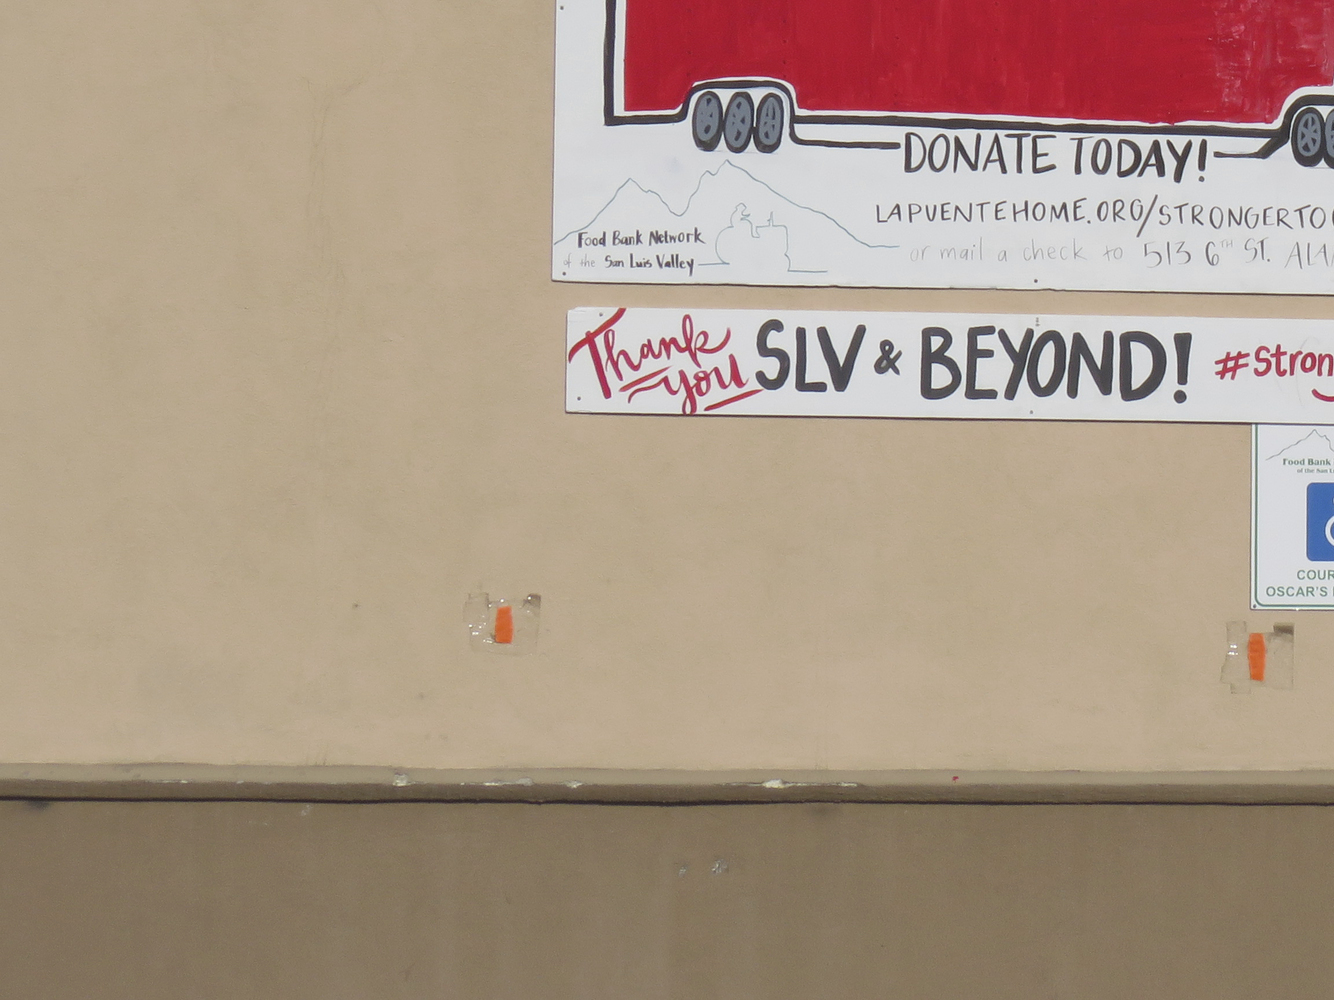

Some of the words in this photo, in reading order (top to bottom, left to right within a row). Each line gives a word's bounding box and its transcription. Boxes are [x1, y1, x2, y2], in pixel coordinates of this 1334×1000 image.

[902, 132, 1057, 175] DONATE
[1070, 136, 1208, 183] TODAY!
[578, 231, 606, 248] Food
[612, 230, 643, 246] Bank
[649, 227, 706, 246] Network
[909, 247, 931, 262] or
[940, 238, 983, 261] mail
[997, 247, 1008, 262] a
[1023, 238, 1087, 261] check
[1103, 241, 1123, 261] to
[1142, 240, 1192, 268] 513
[1244, 238, 1271, 263] ST.
[563, 253, 572, 268] of
[580, 254, 595, 267] the
[605, 255, 624, 268] San
[630, 253, 652, 268] Luis
[656, 254, 694, 276] Valley
[568, 308, 731, 398] Thank
[755, 319, 866, 392] SLV
[920, 326, 1193, 404] BEYOND!
[628, 354, 750, 414] you
[1266, 586, 1328, 597] OSCAR'S
